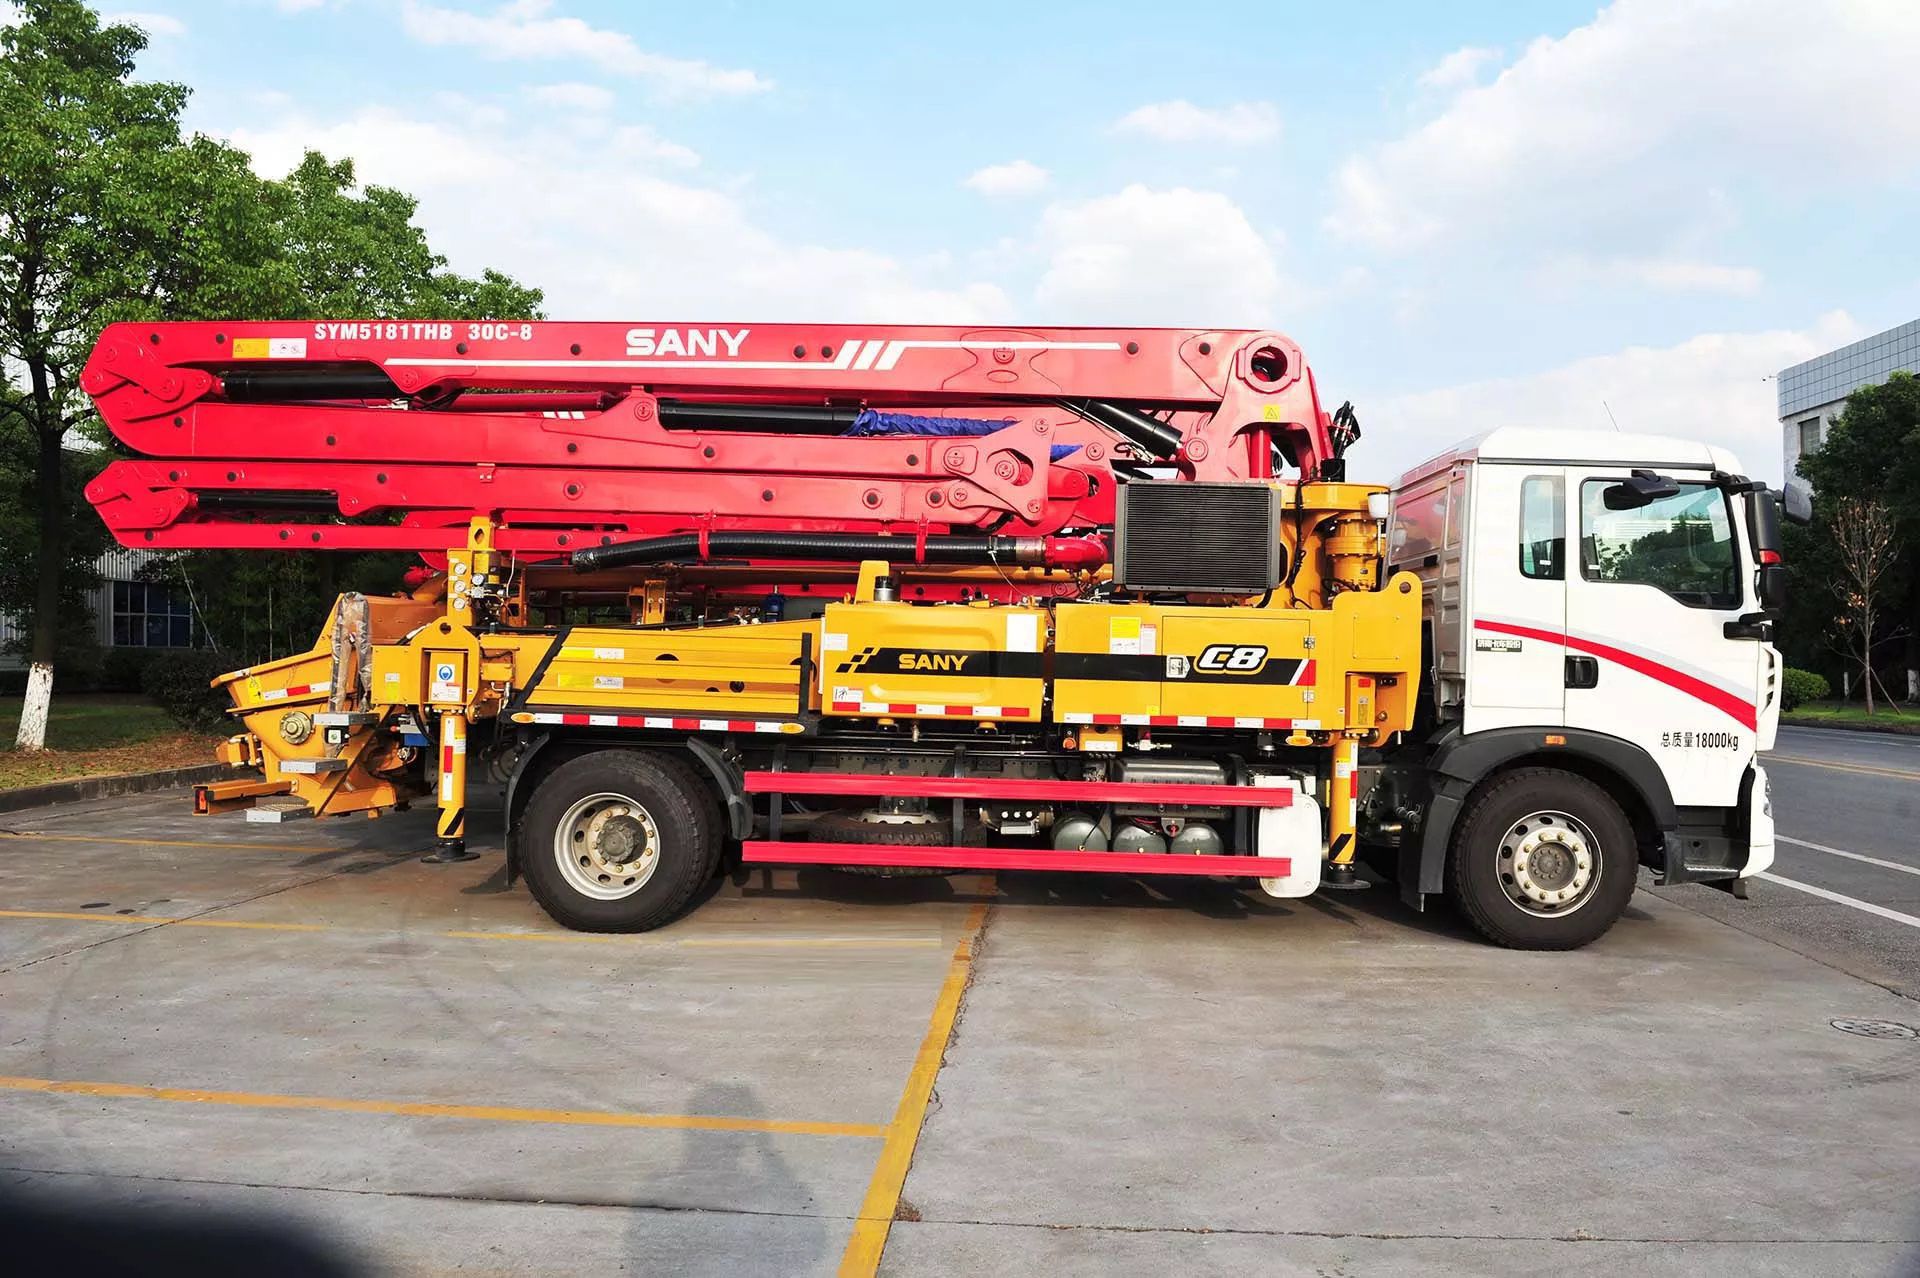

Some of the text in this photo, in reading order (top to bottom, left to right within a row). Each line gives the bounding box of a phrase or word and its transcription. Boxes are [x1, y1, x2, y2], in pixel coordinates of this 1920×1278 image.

[314, 323, 533, 340] SYM5181THB 30C-8
[625, 328, 751, 357] SANY
[898, 653, 969, 671] SANY
[1660, 731, 1739, 752] 总质量18000kg
